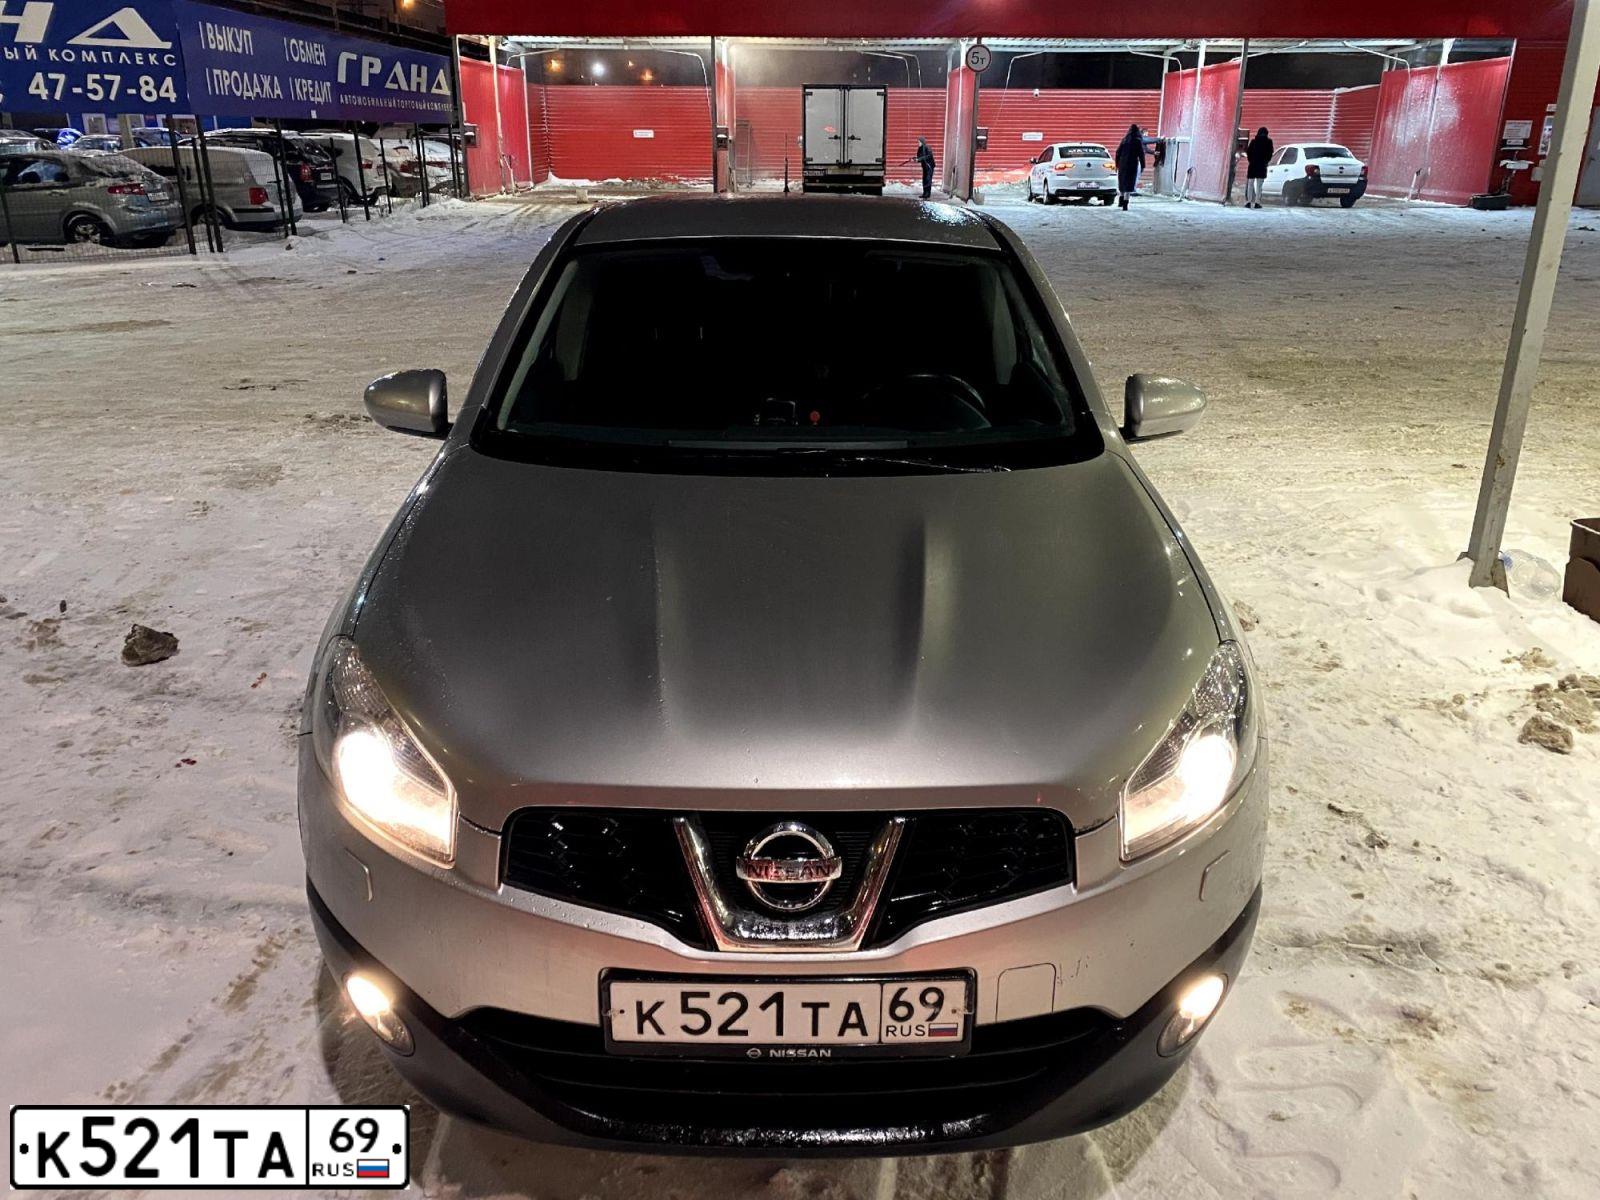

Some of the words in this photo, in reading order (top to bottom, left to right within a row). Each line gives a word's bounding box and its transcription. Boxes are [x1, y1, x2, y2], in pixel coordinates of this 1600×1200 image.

[206, 22, 254, 55] ВЫКУП
[290, 38, 327, 66] ОБМЕН
[48, 49, 177, 66] КОМПЛЕКС
[28, 72, 177, 103] 47-57-84
[213, 69, 283, 100] ПРОДАЖА
[337, 51, 451, 96] ГРАНД
[295, 78, 332, 105] КРЕДИТ
[636, 991, 869, 1037] К521ТА
[889, 987, 945, 1023] 69
[886, 1024, 926, 1037] RUS
[769, 1048, 832, 1058] NISSAN
